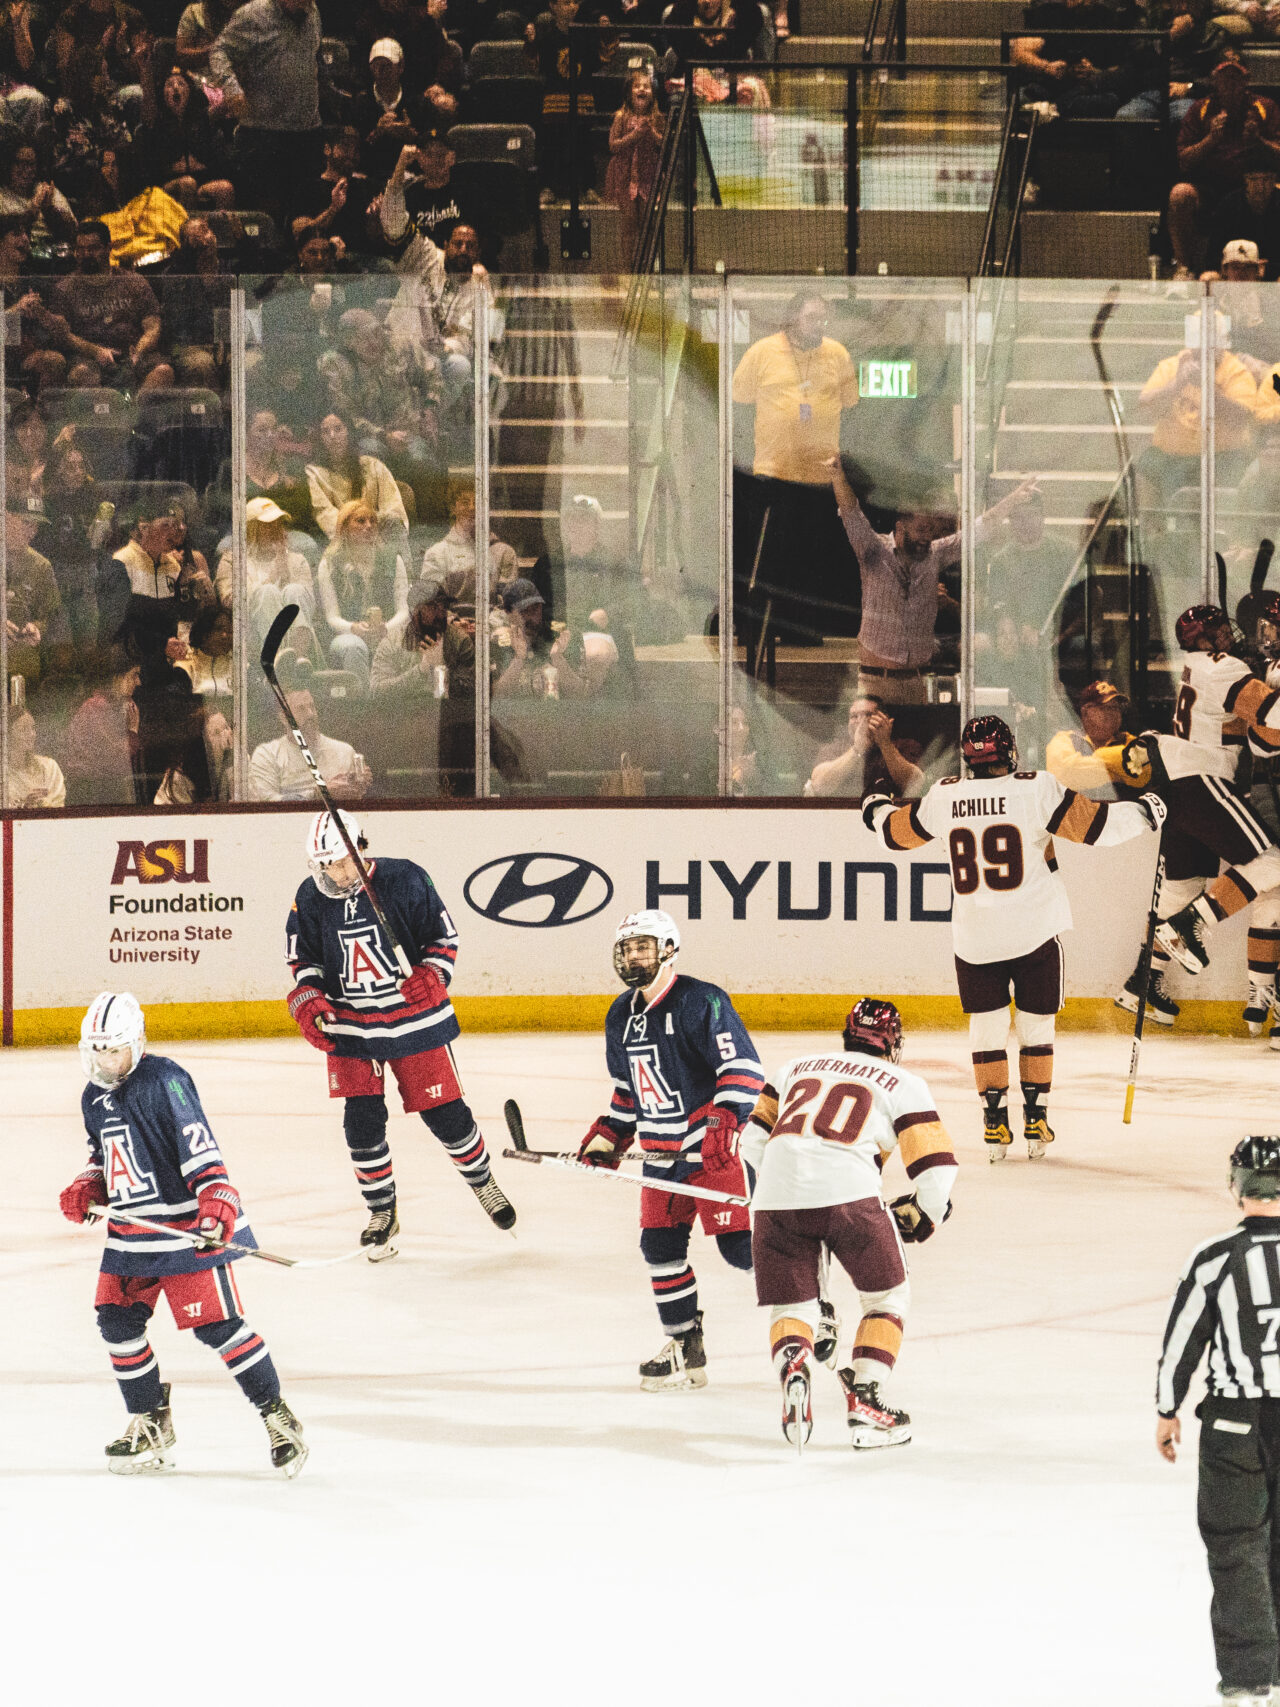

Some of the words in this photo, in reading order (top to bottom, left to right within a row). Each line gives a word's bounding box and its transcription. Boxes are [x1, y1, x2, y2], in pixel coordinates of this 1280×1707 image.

[869, 363, 912, 397] EXIT
[291, 729, 327, 786] CCM
[952, 797, 1006, 819] ACHILLE
[110, 838, 211, 885] ASU
[949, 823, 1024, 896] 89
[109, 892, 244, 914] Foundation
[646, 860, 954, 922] HYUND
[110, 927, 180, 943] Arizona
[184, 925, 233, 941] State
[109, 946, 201, 964] University
[715, 1031, 737, 1061] 5
[790, 1058, 900, 1092] NIEDERMAYER
[768, 1078, 873, 1145] 20
[182, 1122, 217, 1155] 22
